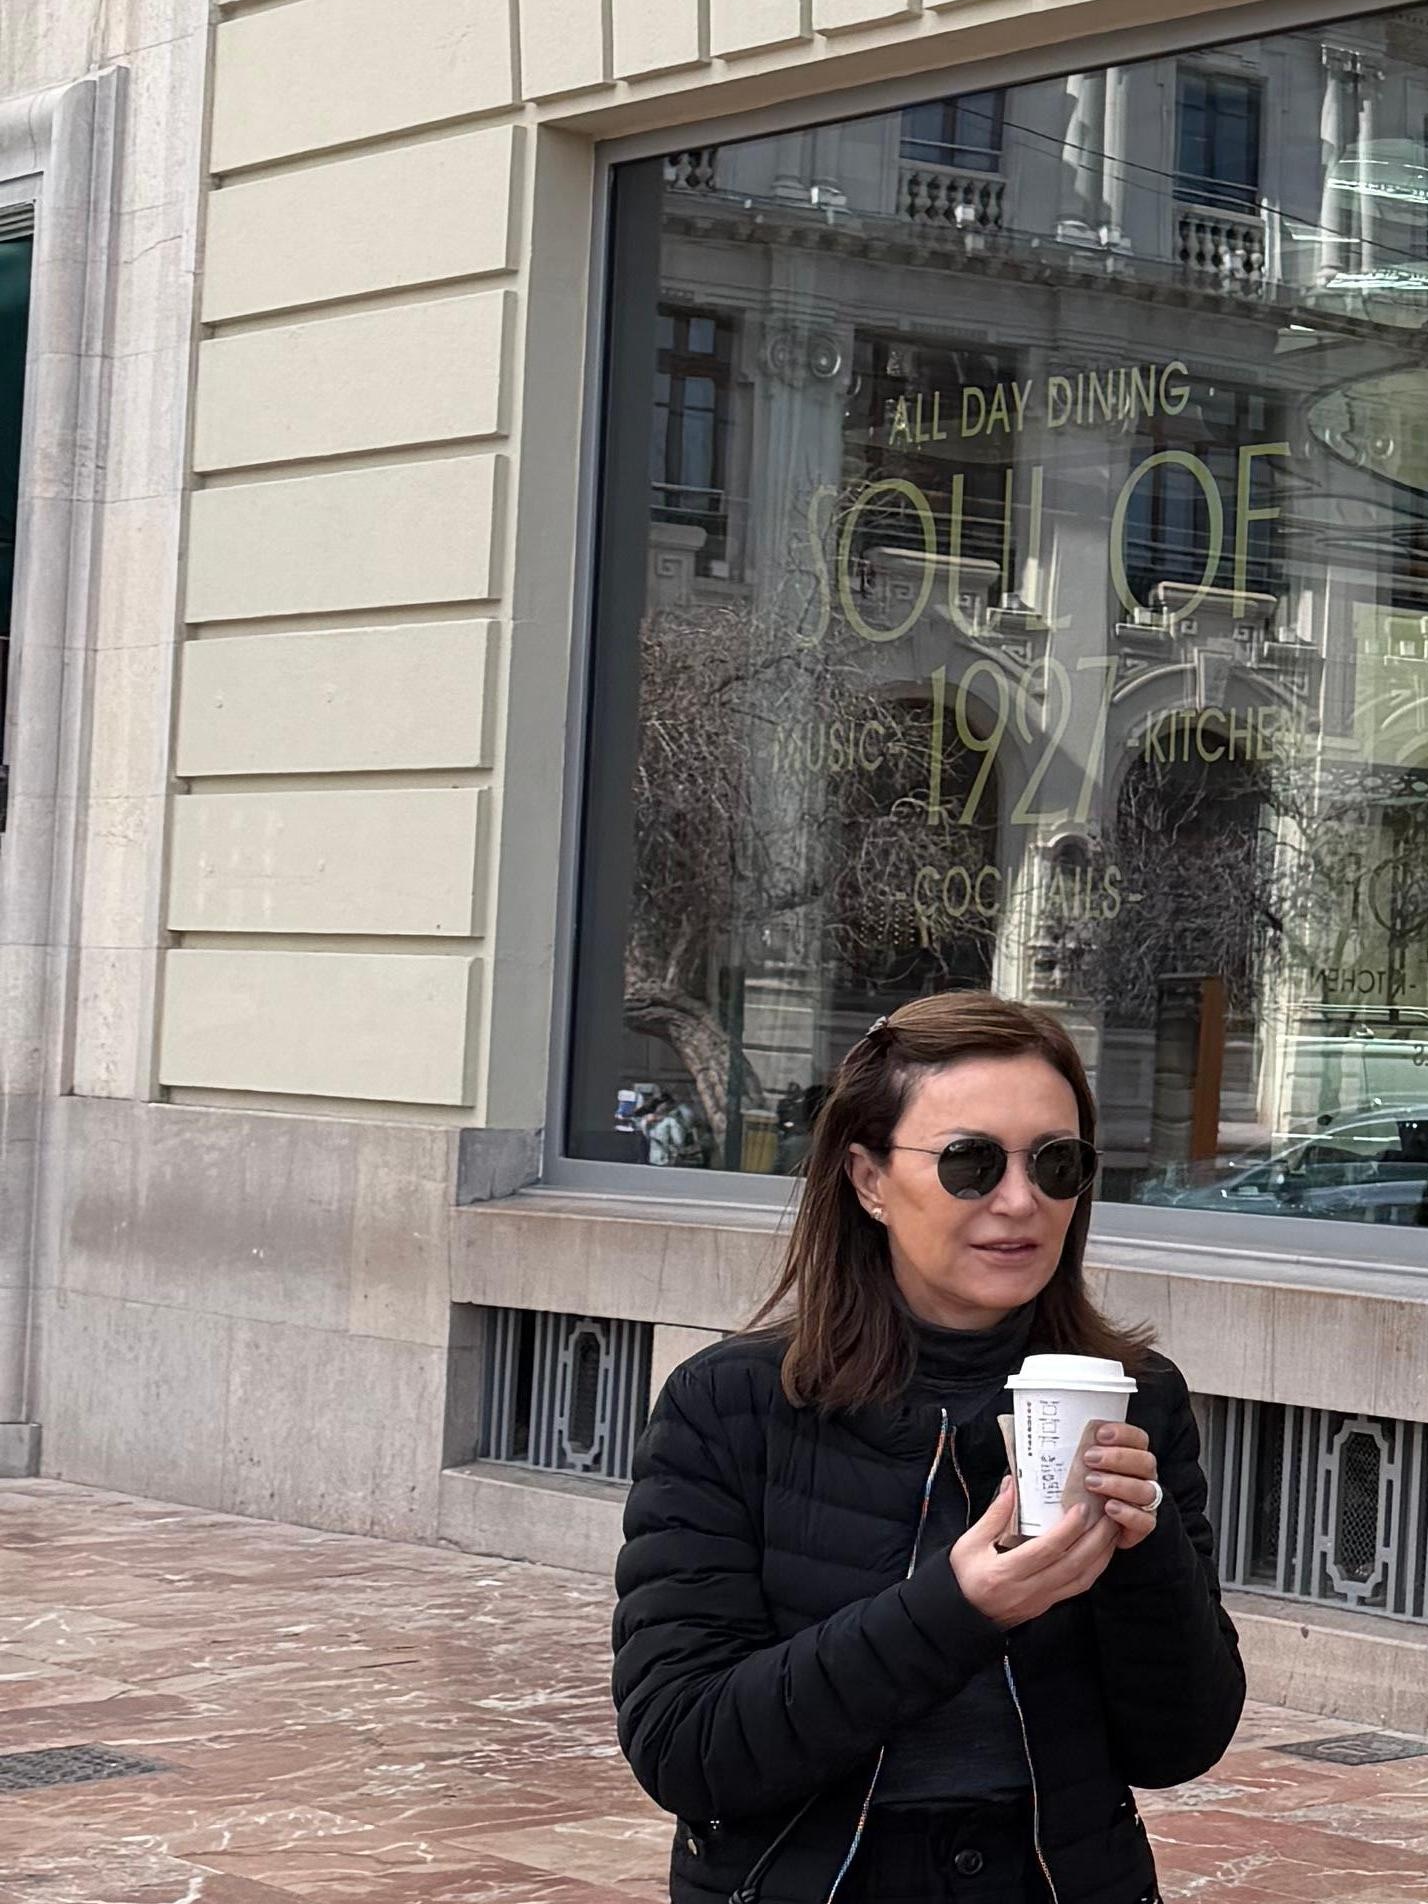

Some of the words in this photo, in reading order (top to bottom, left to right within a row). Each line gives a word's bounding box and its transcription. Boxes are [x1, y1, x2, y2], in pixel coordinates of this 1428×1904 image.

[888, 390, 947, 446] ALL
[960, 379, 1033, 437] DAY
[1048, 360, 1191, 429] DINING
[797, 465, 1073, 648] SOUL
[1110, 441, 1292, 627] OF
[926, 654, 1120, 826] 1927
